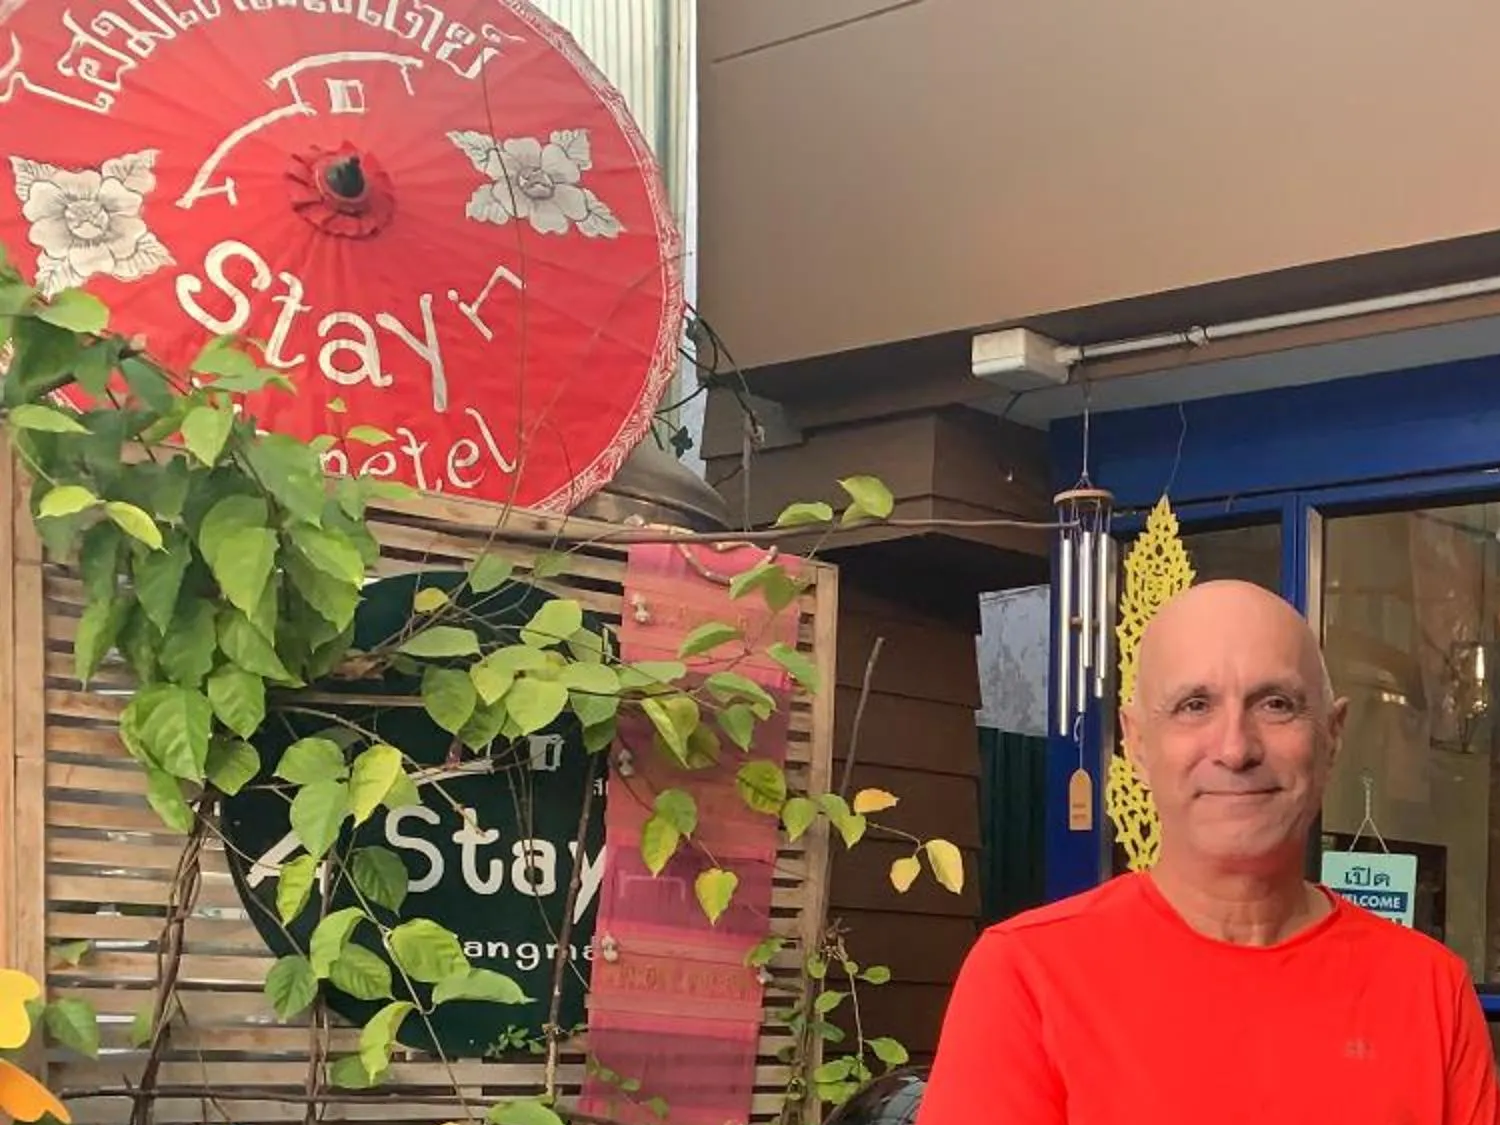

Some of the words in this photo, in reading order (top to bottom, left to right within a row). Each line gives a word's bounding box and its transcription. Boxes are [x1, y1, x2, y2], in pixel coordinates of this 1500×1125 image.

[174, 238, 448, 413] Stay
[384, 804, 607, 924] Stay
[1344, 865, 1391, 887] เปิด
[1342, 893, 1401, 910] LCOME
